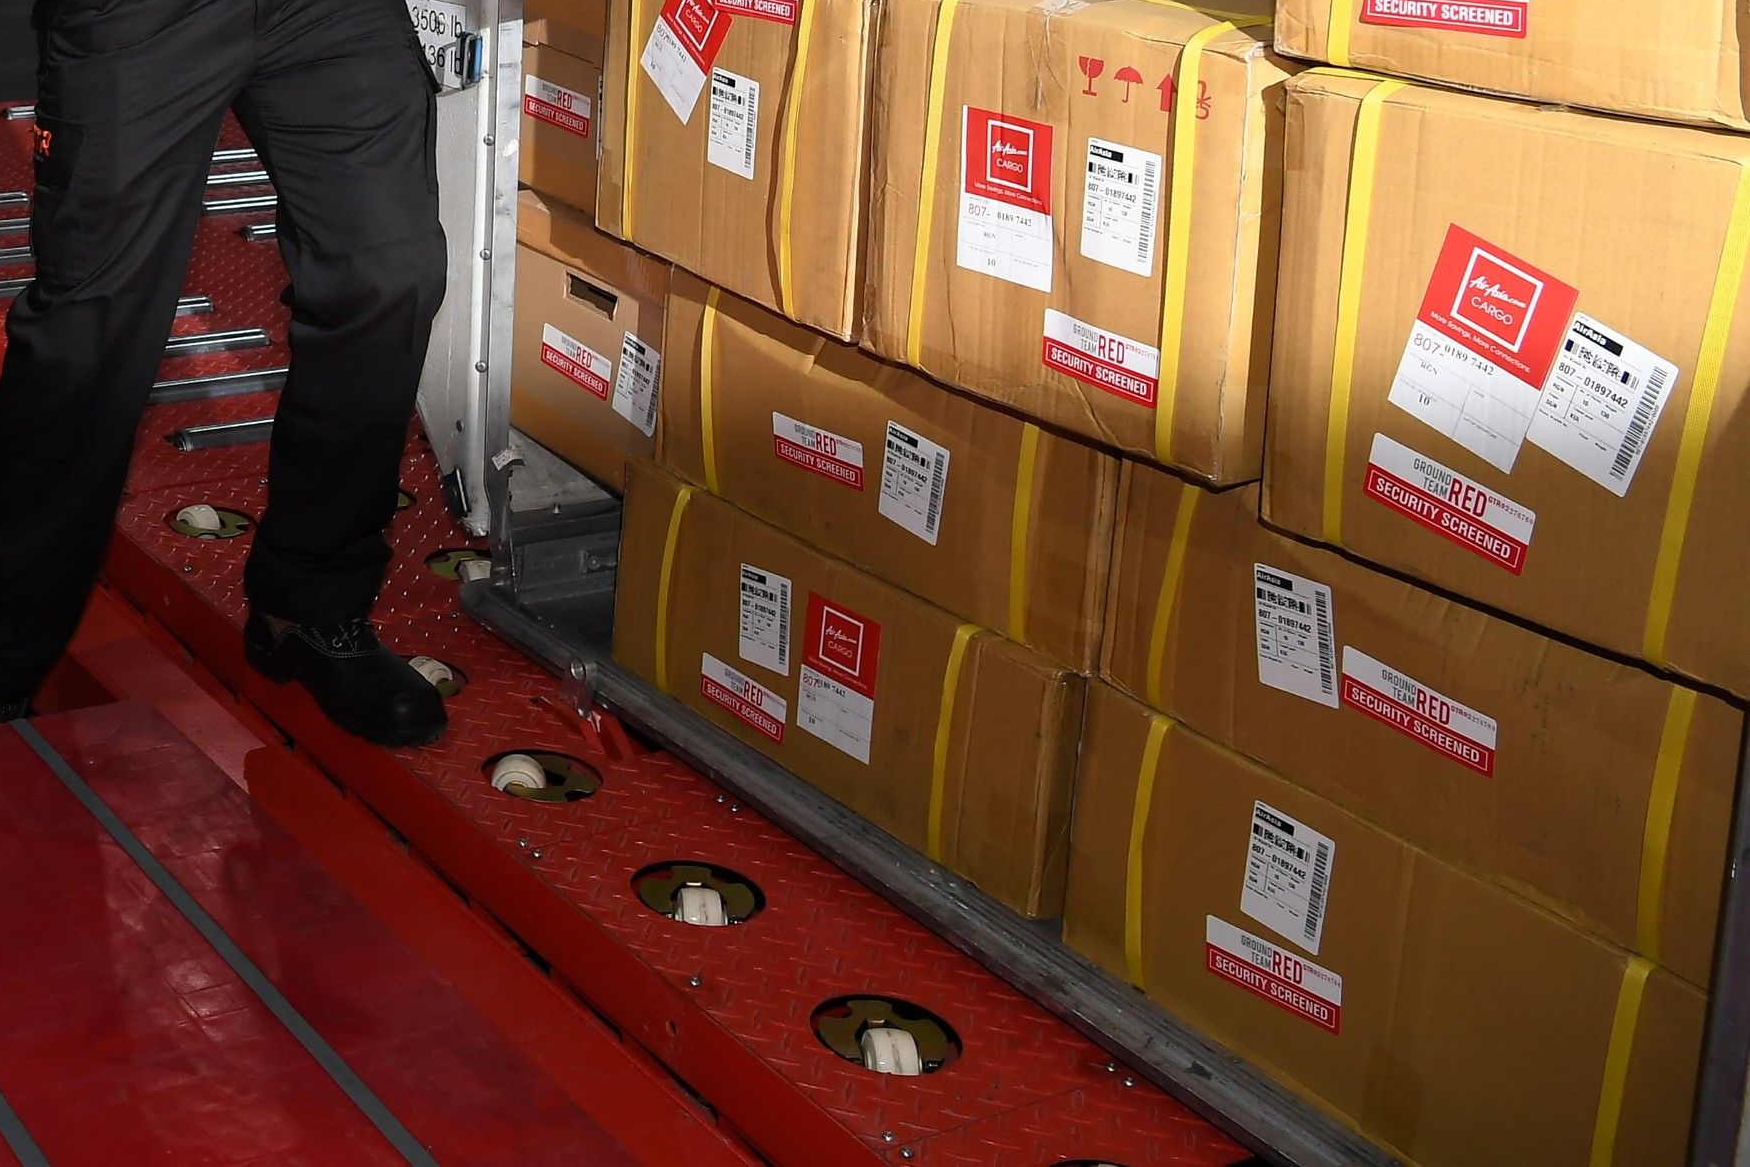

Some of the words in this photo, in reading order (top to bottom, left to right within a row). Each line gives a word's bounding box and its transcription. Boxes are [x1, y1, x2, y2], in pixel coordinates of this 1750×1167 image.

[754, 0, 791, 17] SCREENED
[1441, 3, 1514, 27] SCREENED
[450, 14, 462, 38] lb
[557, 90, 572, 110] RED
[529, 100, 555, 119] SECURITY
[555, 111, 584, 131] SCREENED
[996, 158, 1023, 174] CARGO
[1088, 182, 1099, 192] 807
[1105, 187, 1137, 204] 01897442
[997, 211, 1014, 222] 0189
[1016, 216, 1032, 227] 7442
[1471, 296, 1513, 325] CARGO
[1073, 323, 1098, 342] GROUND
[1431, 311, 1447, 324] More
[1472, 334, 1489, 349] More
[1574, 320, 1607, 346] AirAsia
[576, 346, 592, 368] RED
[1081, 338, 1098, 355] TEAM
[1098, 334, 1125, 364] RED
[1444, 344, 1468, 362] 0189
[1471, 357, 1494, 375] 7442
[546, 350, 573, 373] SECURITY
[573, 366, 603, 393] SCREENED
[1051, 347, 1094, 375] SECURITY
[1095, 366, 1147, 396] SCREENED
[1558, 361, 1576, 377] 807
[1583, 376, 1629, 409] 01897442
[1418, 393, 1430, 407] 10
[815, 432, 836, 456] RED
[780, 443, 815, 466] SECURITY
[816, 459, 856, 482] SCREENED
[1413, 458, 1452, 486] GROUND
[1423, 477, 1449, 499] TEAM
[1448, 477, 1488, 518] RED
[1376, 477, 1440, 520] SECURITY
[1441, 512, 1511, 560] SCREENED
[1258, 608, 1271, 620] 807
[1278, 615, 1312, 634] 01897442
[828, 640, 853, 658] CARGO
[743, 680, 763, 707] RED
[1381, 668, 1417, 696] GROUND
[706, 683, 740, 710] SECURITY
[741, 705, 777, 735] SCREENED
[1392, 686, 1416, 708] TEAM
[1415, 688, 1450, 726] RED
[1352, 687, 1411, 727] SECURITY
[1413, 719, 1480, 763] SCREENED
[1252, 843, 1265, 855] 807
[1271, 853, 1307, 880] 01897442
[1241, 935, 1272, 958] GROUND
[1250, 951, 1271, 971] TEAM
[1272, 950, 1303, 985] RED
[1215, 955, 1268, 990] SECURITY
[1270, 983, 1328, 1021] SCREENED
